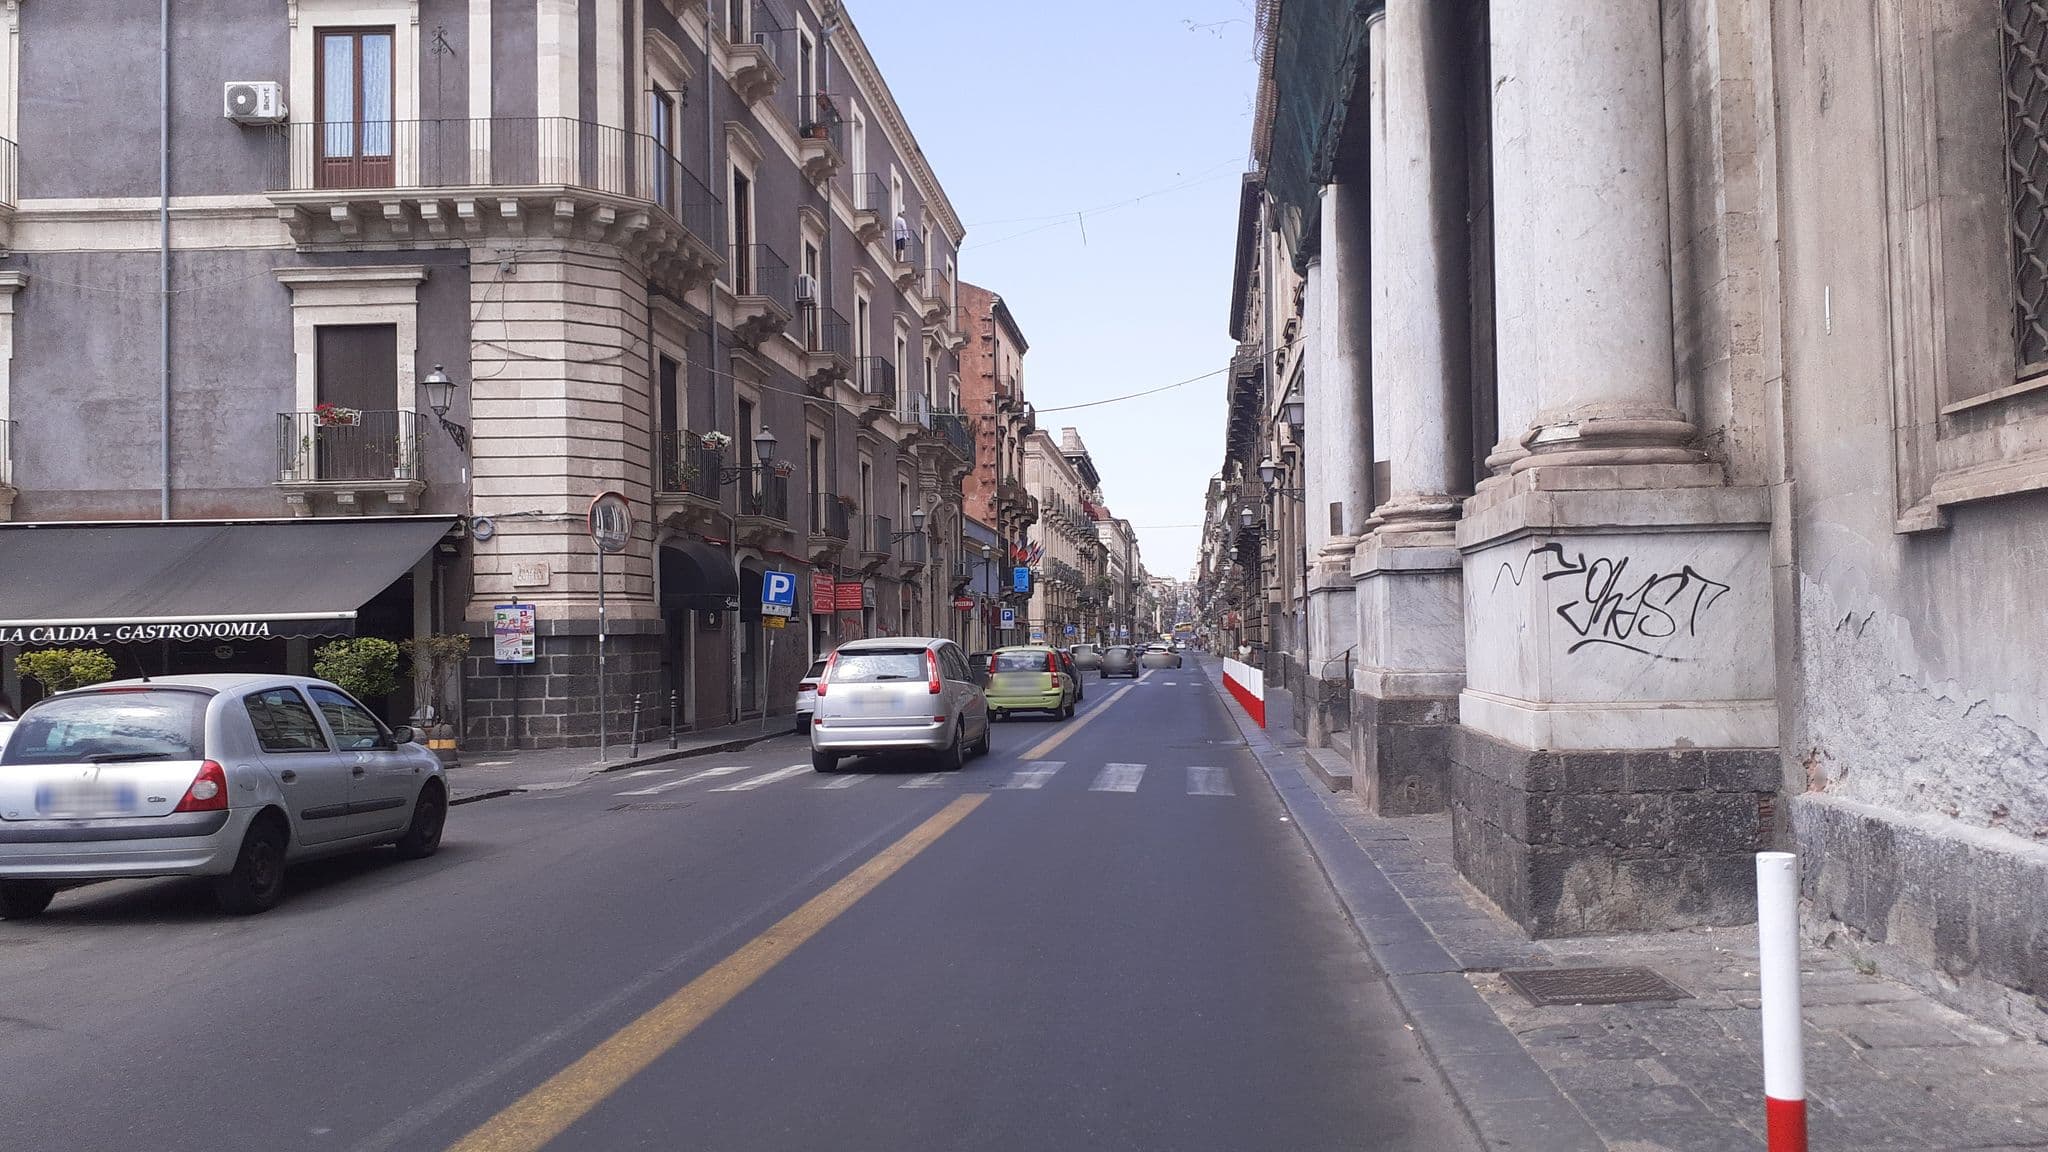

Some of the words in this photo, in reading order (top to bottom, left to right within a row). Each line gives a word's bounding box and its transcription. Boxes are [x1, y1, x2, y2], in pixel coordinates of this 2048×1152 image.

[769, 574, 790, 601] P
[1004, 611, 1011, 620] P
[0, 628, 24, 641] LA
[29, 627, 98, 641] CALDA
[116, 622, 270, 640] GASTRONOMIA
